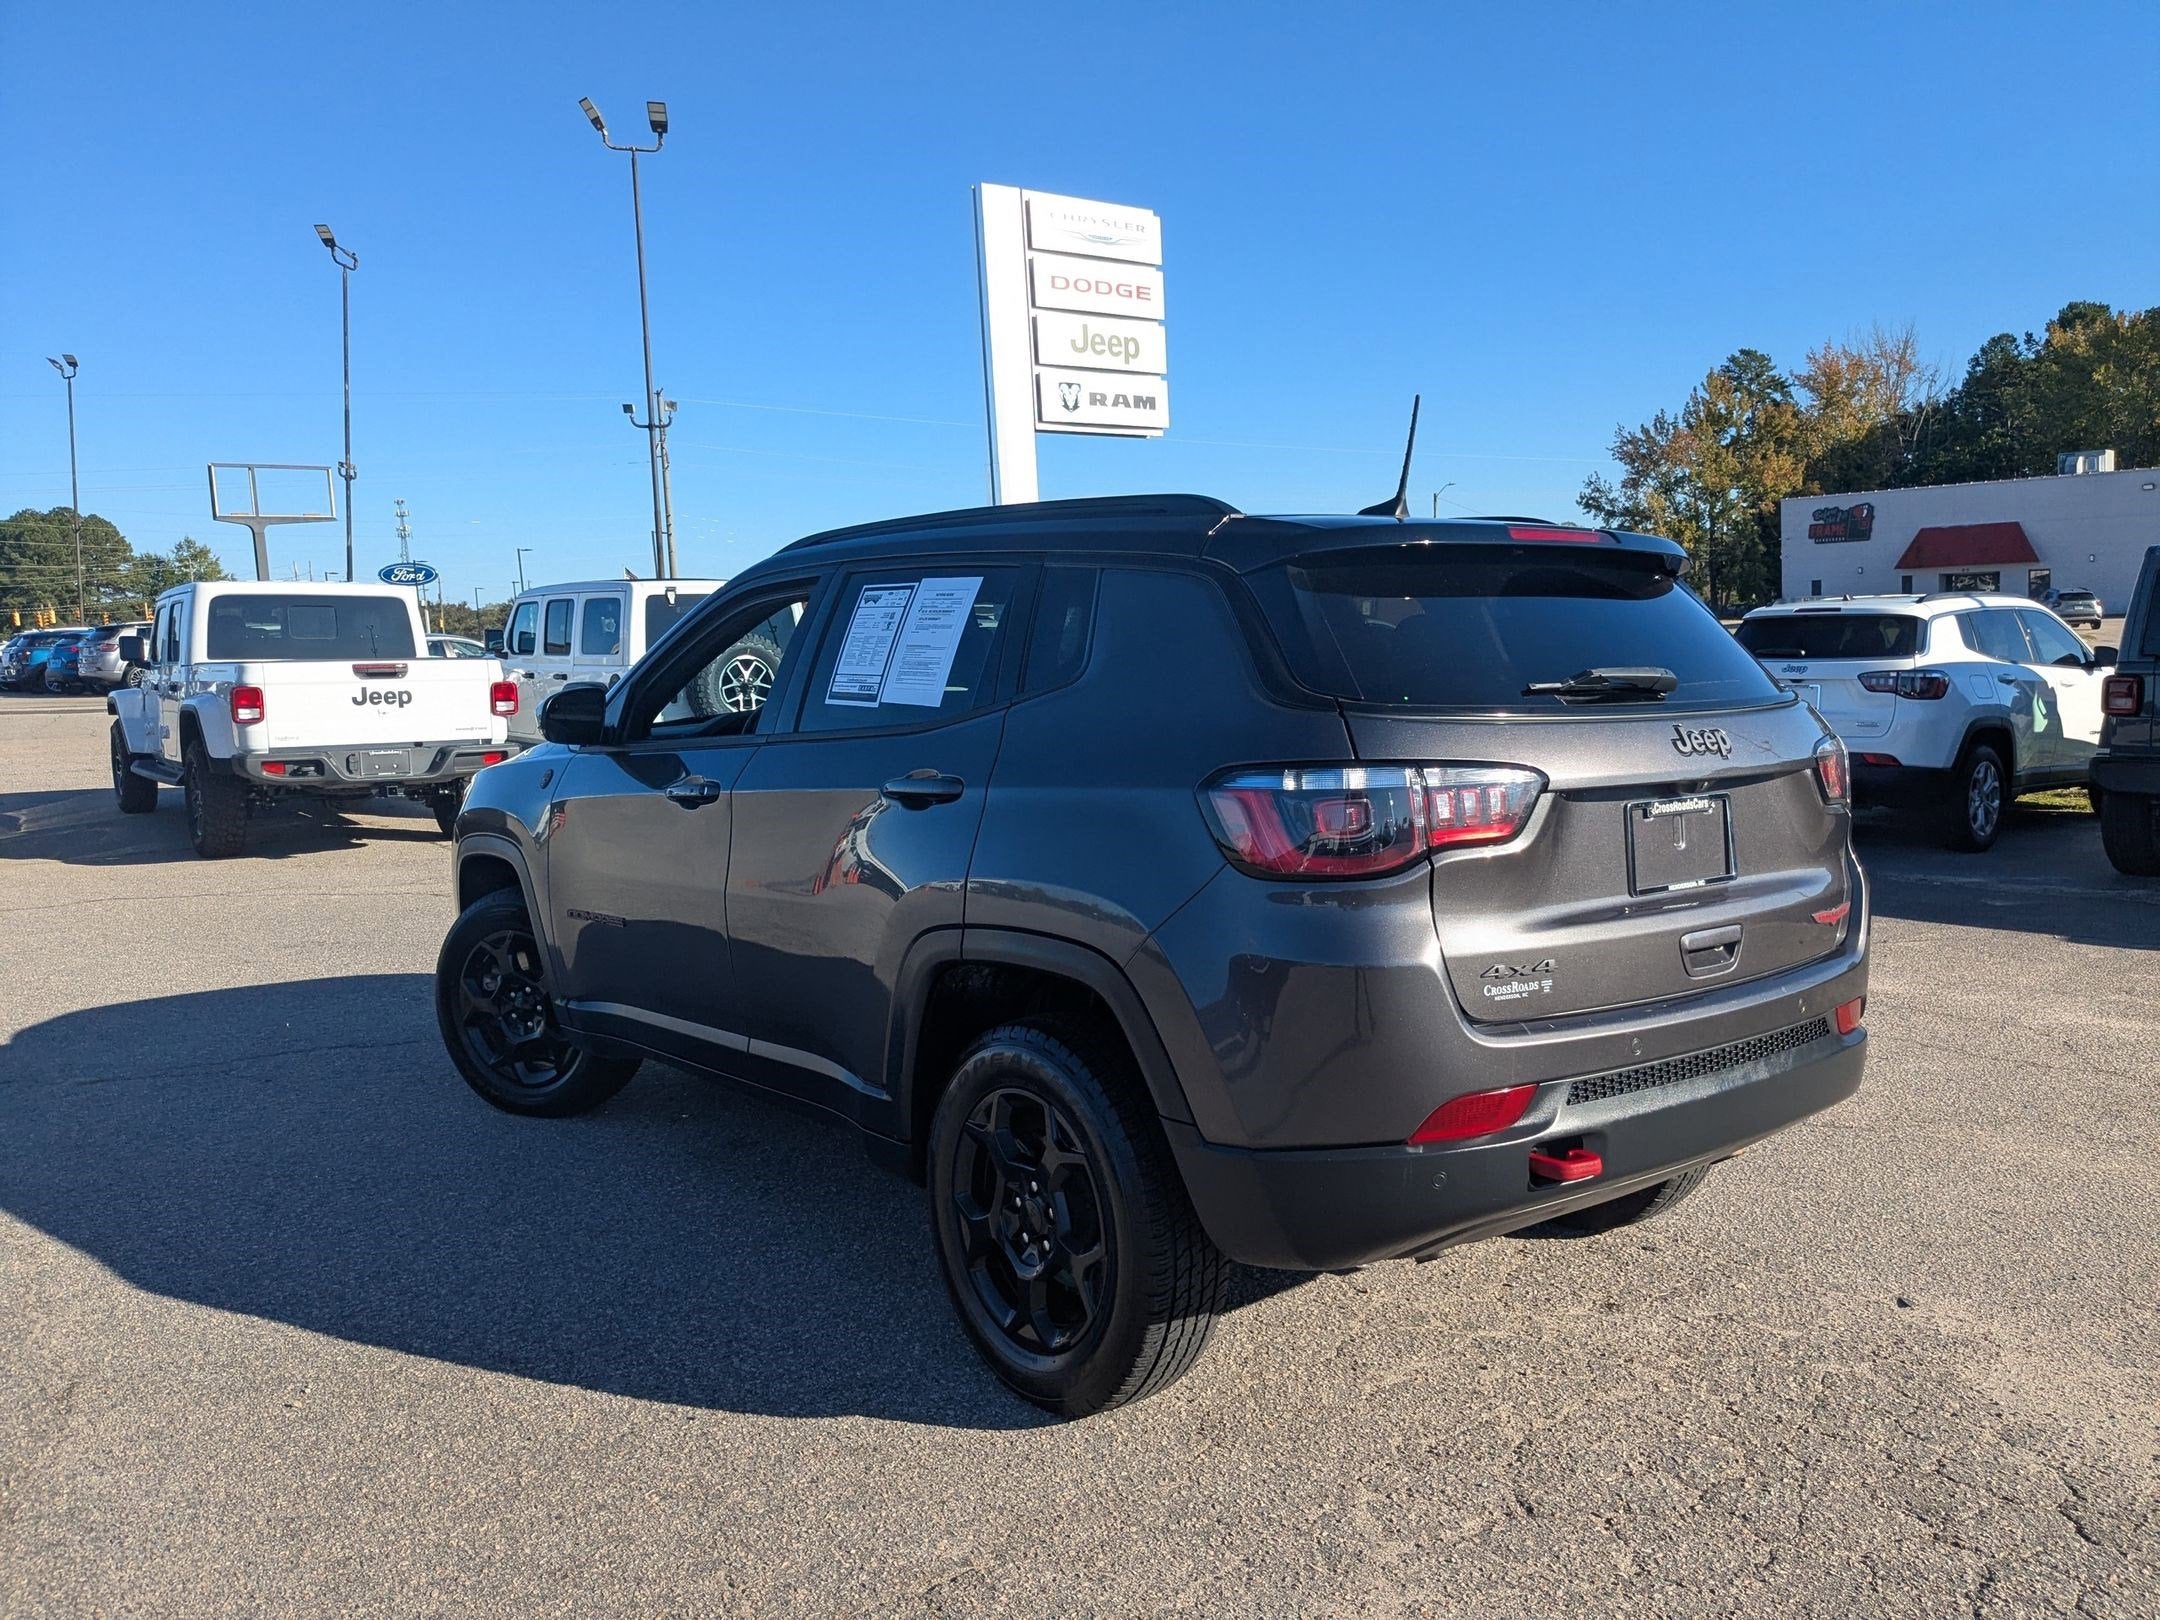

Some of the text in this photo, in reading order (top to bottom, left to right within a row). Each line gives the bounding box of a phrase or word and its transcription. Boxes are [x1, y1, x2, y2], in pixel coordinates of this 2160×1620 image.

[1050, 275, 1152, 302] DODGE
[1070, 323, 1140, 365] Jeep
[1088, 391, 1156, 411] RAM
[391, 567, 426, 581] Ford
[351, 686, 412, 708] Jeep
[1670, 723, 1732, 760] Jeep
